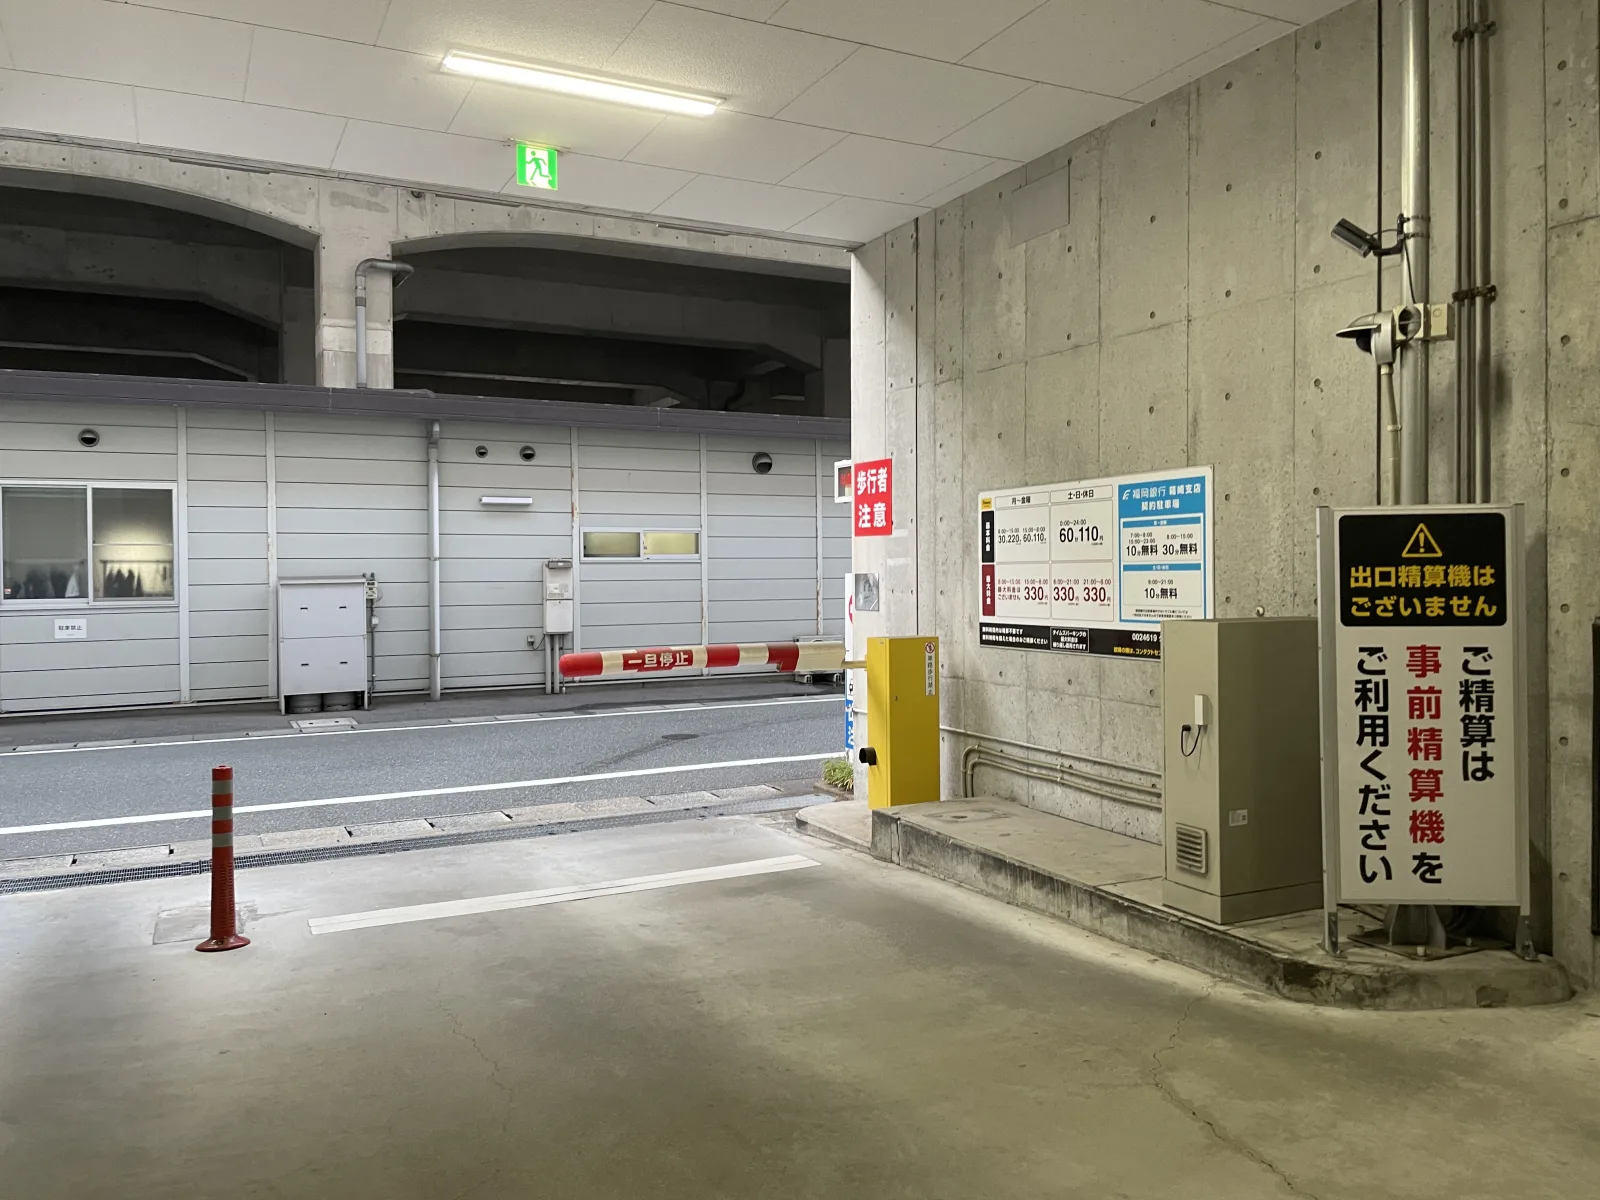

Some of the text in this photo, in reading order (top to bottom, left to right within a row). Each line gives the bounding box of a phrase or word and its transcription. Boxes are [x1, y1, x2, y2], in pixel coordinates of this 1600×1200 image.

[857, 466, 888, 496] 歩行者
[1132, 486, 1165, 498] 福岡銀行
[858, 502, 887, 529] 注意
[1141, 499, 1179, 511] 契約駐車場
[1349, 563, 1496, 589] 出口精算機は
[1350, 596, 1498, 618] ございません
[628, 652, 688, 667] 一旦停止
[1459, 646, 1496, 782] ご精算は
[1354, 646, 1393, 884] ご利用ください
[1405, 644, 1445, 885] 事前精算機を
